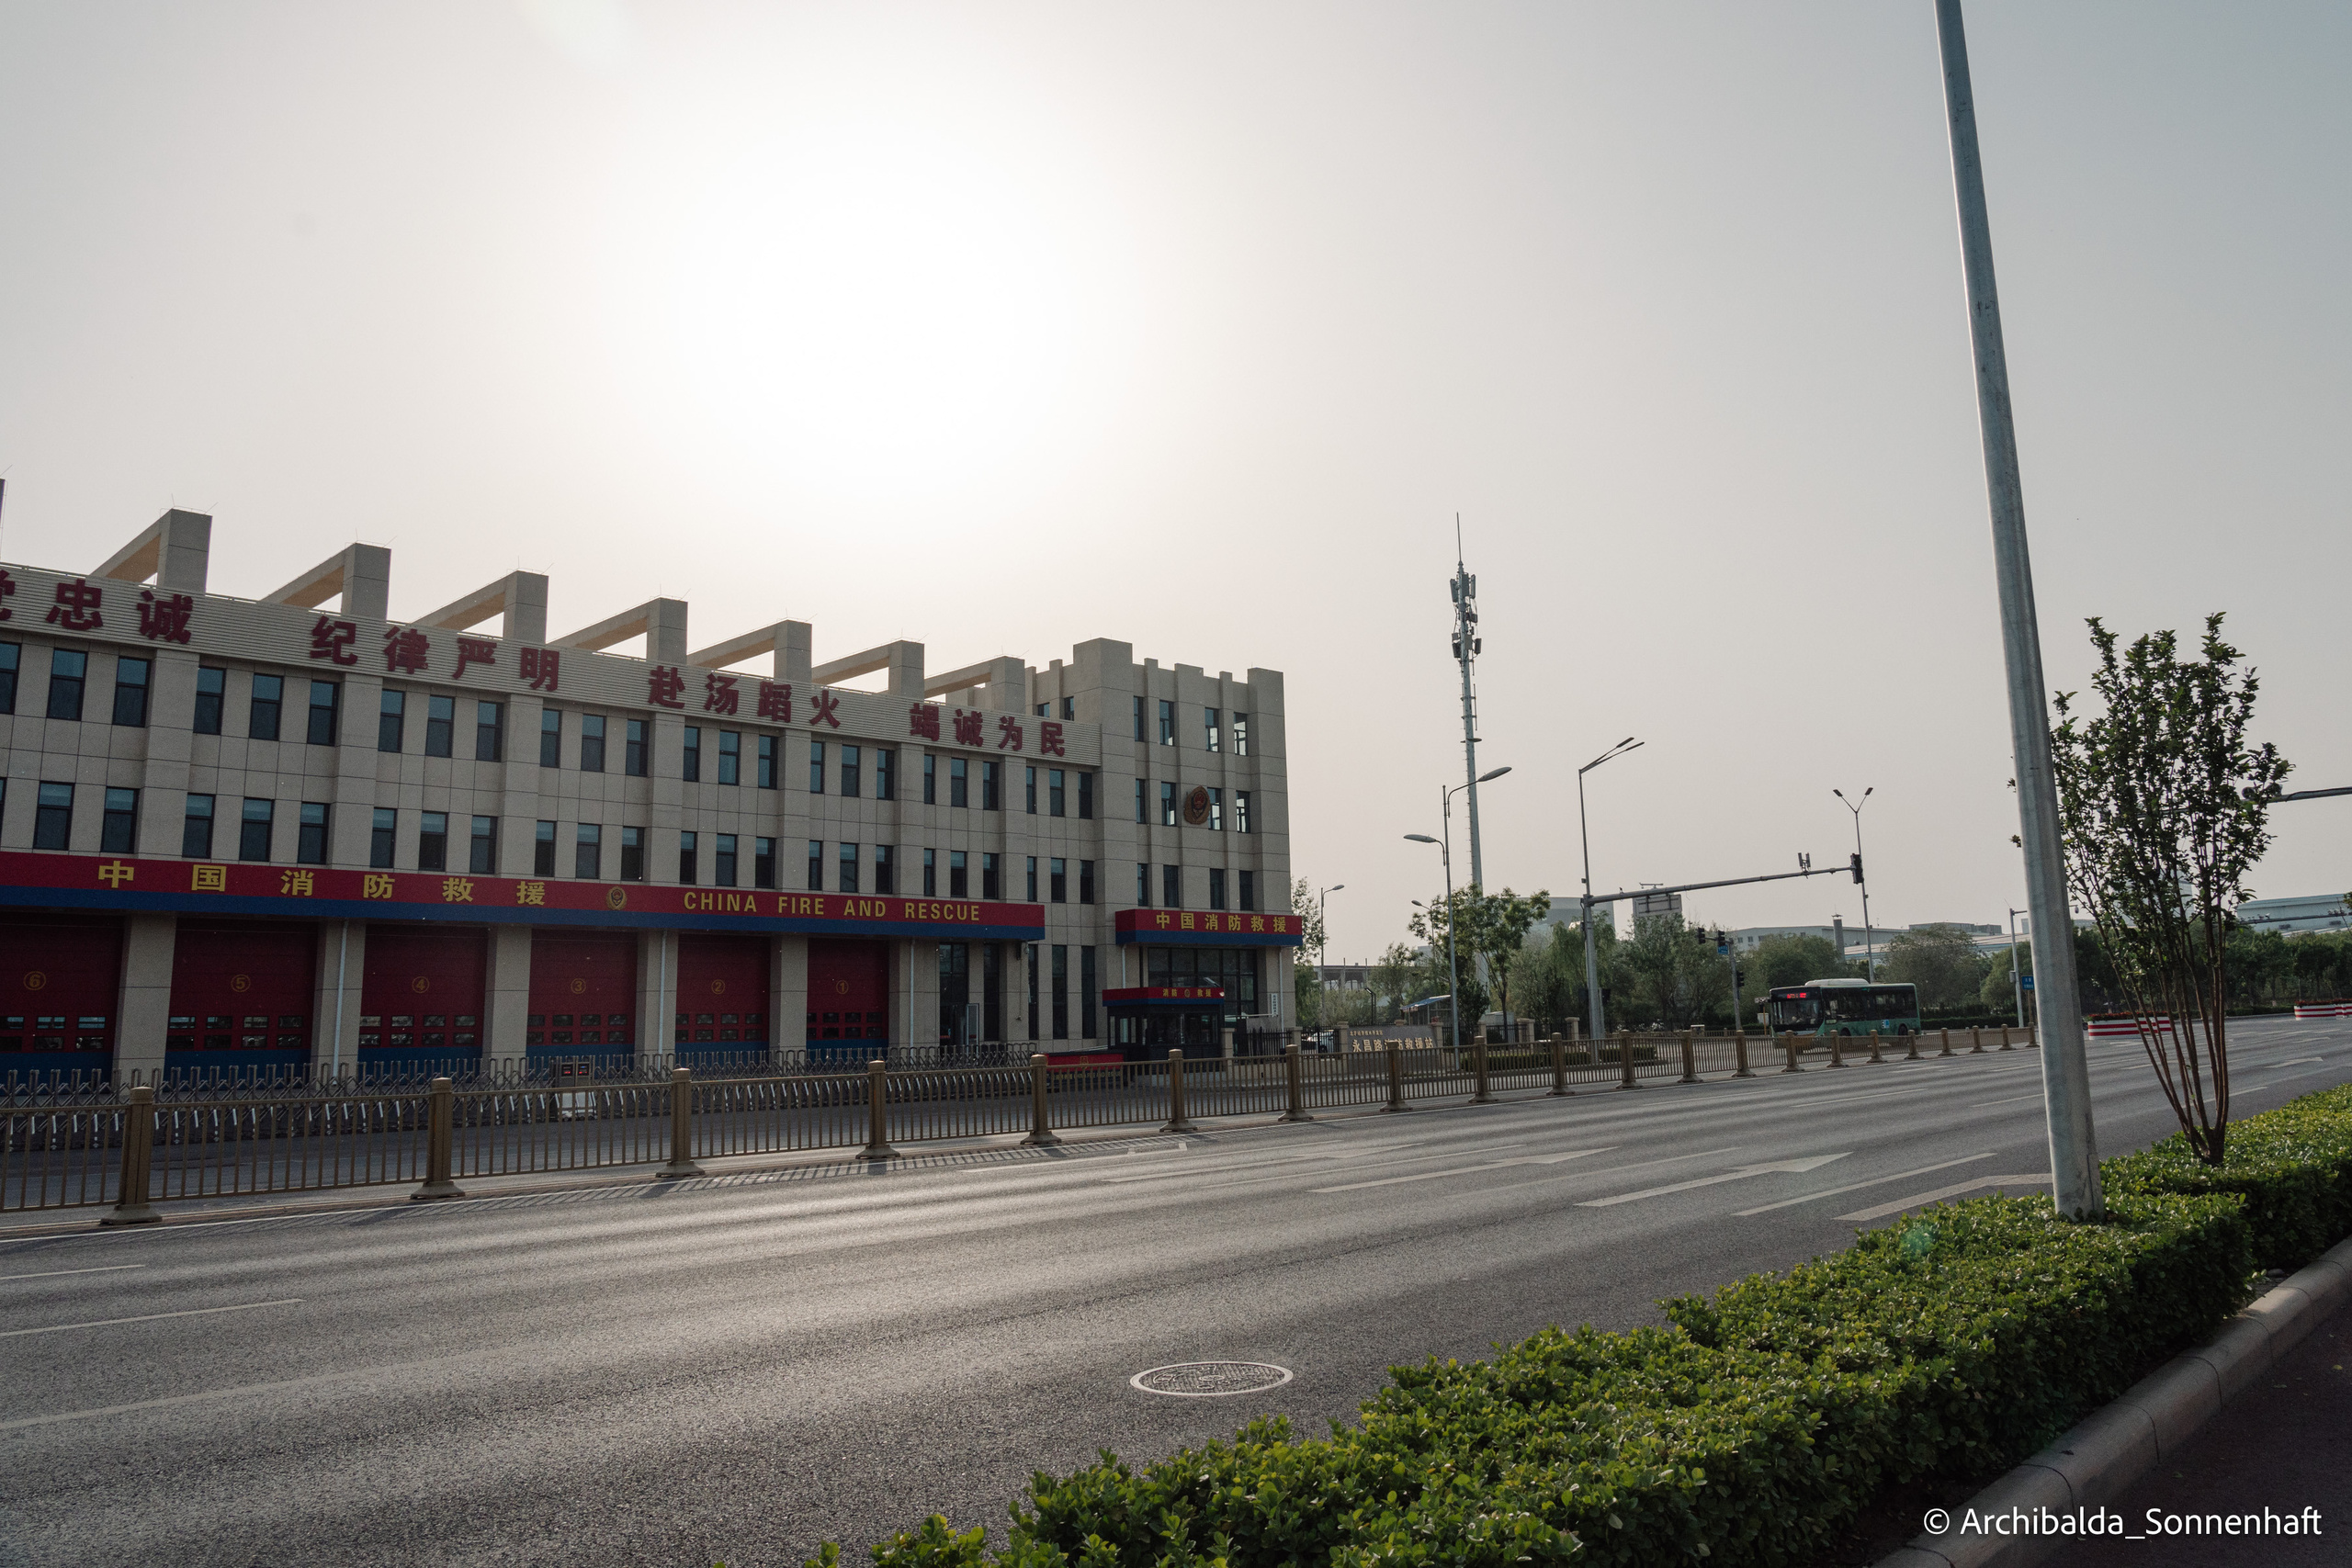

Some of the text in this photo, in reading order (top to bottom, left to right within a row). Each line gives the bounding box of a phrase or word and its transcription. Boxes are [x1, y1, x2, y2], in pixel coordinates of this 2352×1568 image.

[310, 615, 560, 691] 纪律严明
[649, 665, 841, 728] 赴汤蹈火
[910, 703, 1065, 757] 竭诚为民
[97, 860, 546, 906] 中国消防救援
[684, 891, 979, 921] CHINA FIRE AND RESCUE
[1156, 911, 1287, 933] 中国消防救援
